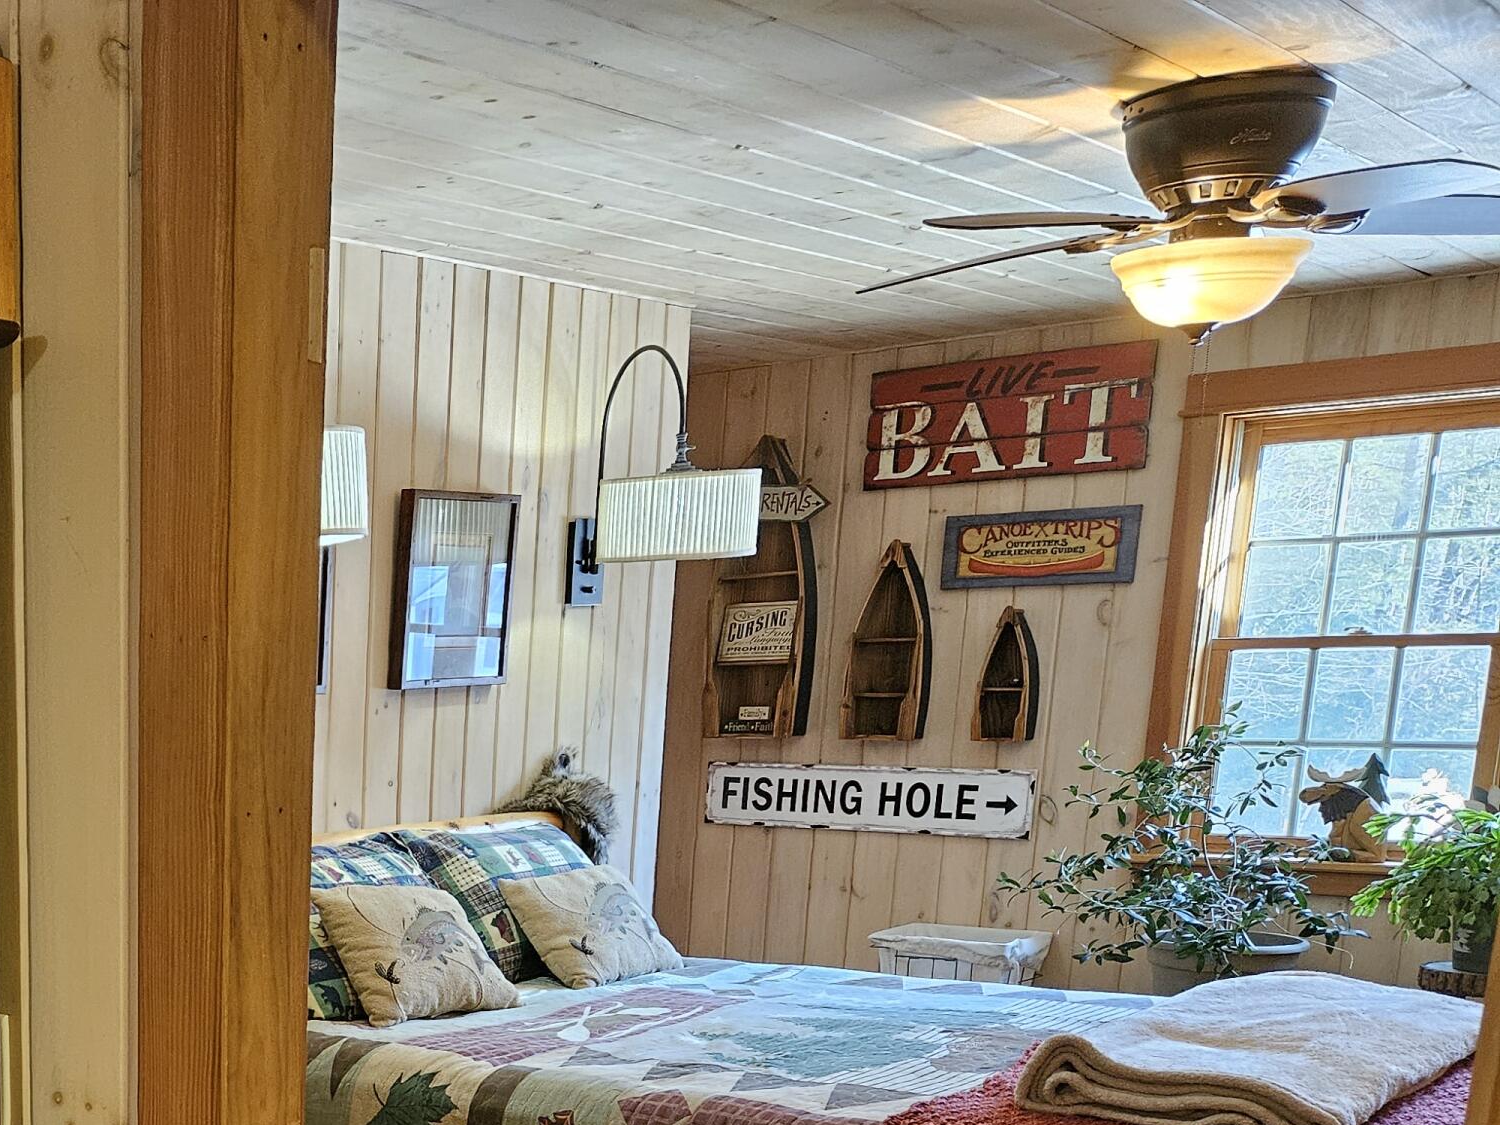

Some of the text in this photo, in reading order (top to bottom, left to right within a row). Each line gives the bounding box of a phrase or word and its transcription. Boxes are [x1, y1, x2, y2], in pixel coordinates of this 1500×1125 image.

[966, 361, 1055, 398] LIVE
[872, 377, 1142, 481] BAIT
[761, 489, 812, 515] RENTALS
[958, 517, 1122, 554] CANOE TRIPS
[1005, 538, 1069, 549] OUTFITTERS
[983, 545, 1086, 558] EXPERIENCED GUIDES
[727, 610, 788, 643] CURSING
[764, 627, 793, 637] Fou
[728, 721, 750, 731] Friend
[721, 776, 980, 820] FISHING HOLE
